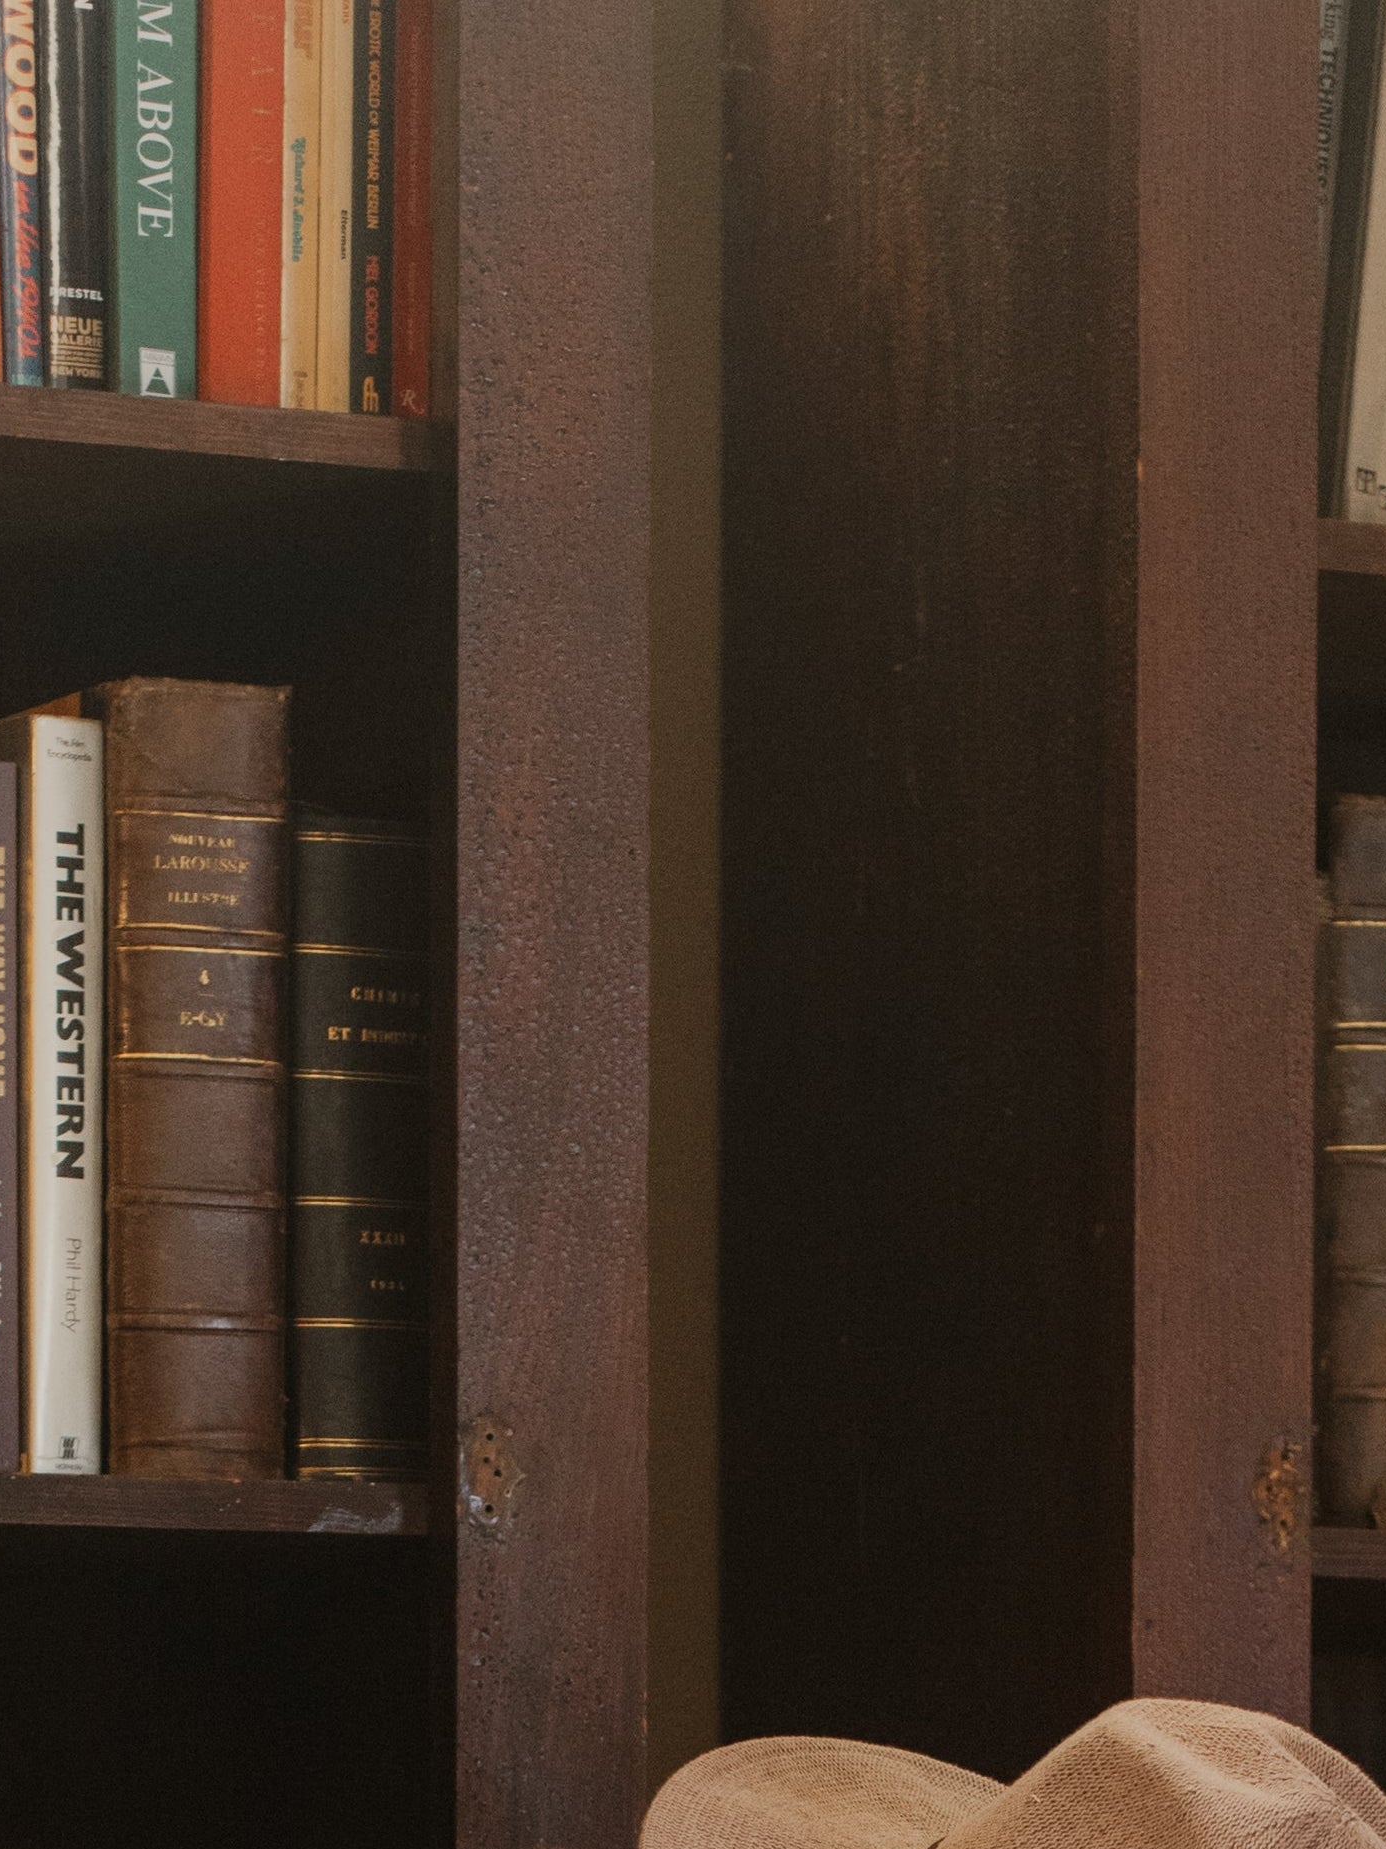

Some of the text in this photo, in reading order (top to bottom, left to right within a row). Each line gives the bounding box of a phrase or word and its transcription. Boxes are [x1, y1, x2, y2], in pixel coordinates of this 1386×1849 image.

[137, 60, 174, 236] ABOVE
[55, 823, 85, 1181] THE WESTERN
[60, 1237, 83, 1334] Phil Hardy
